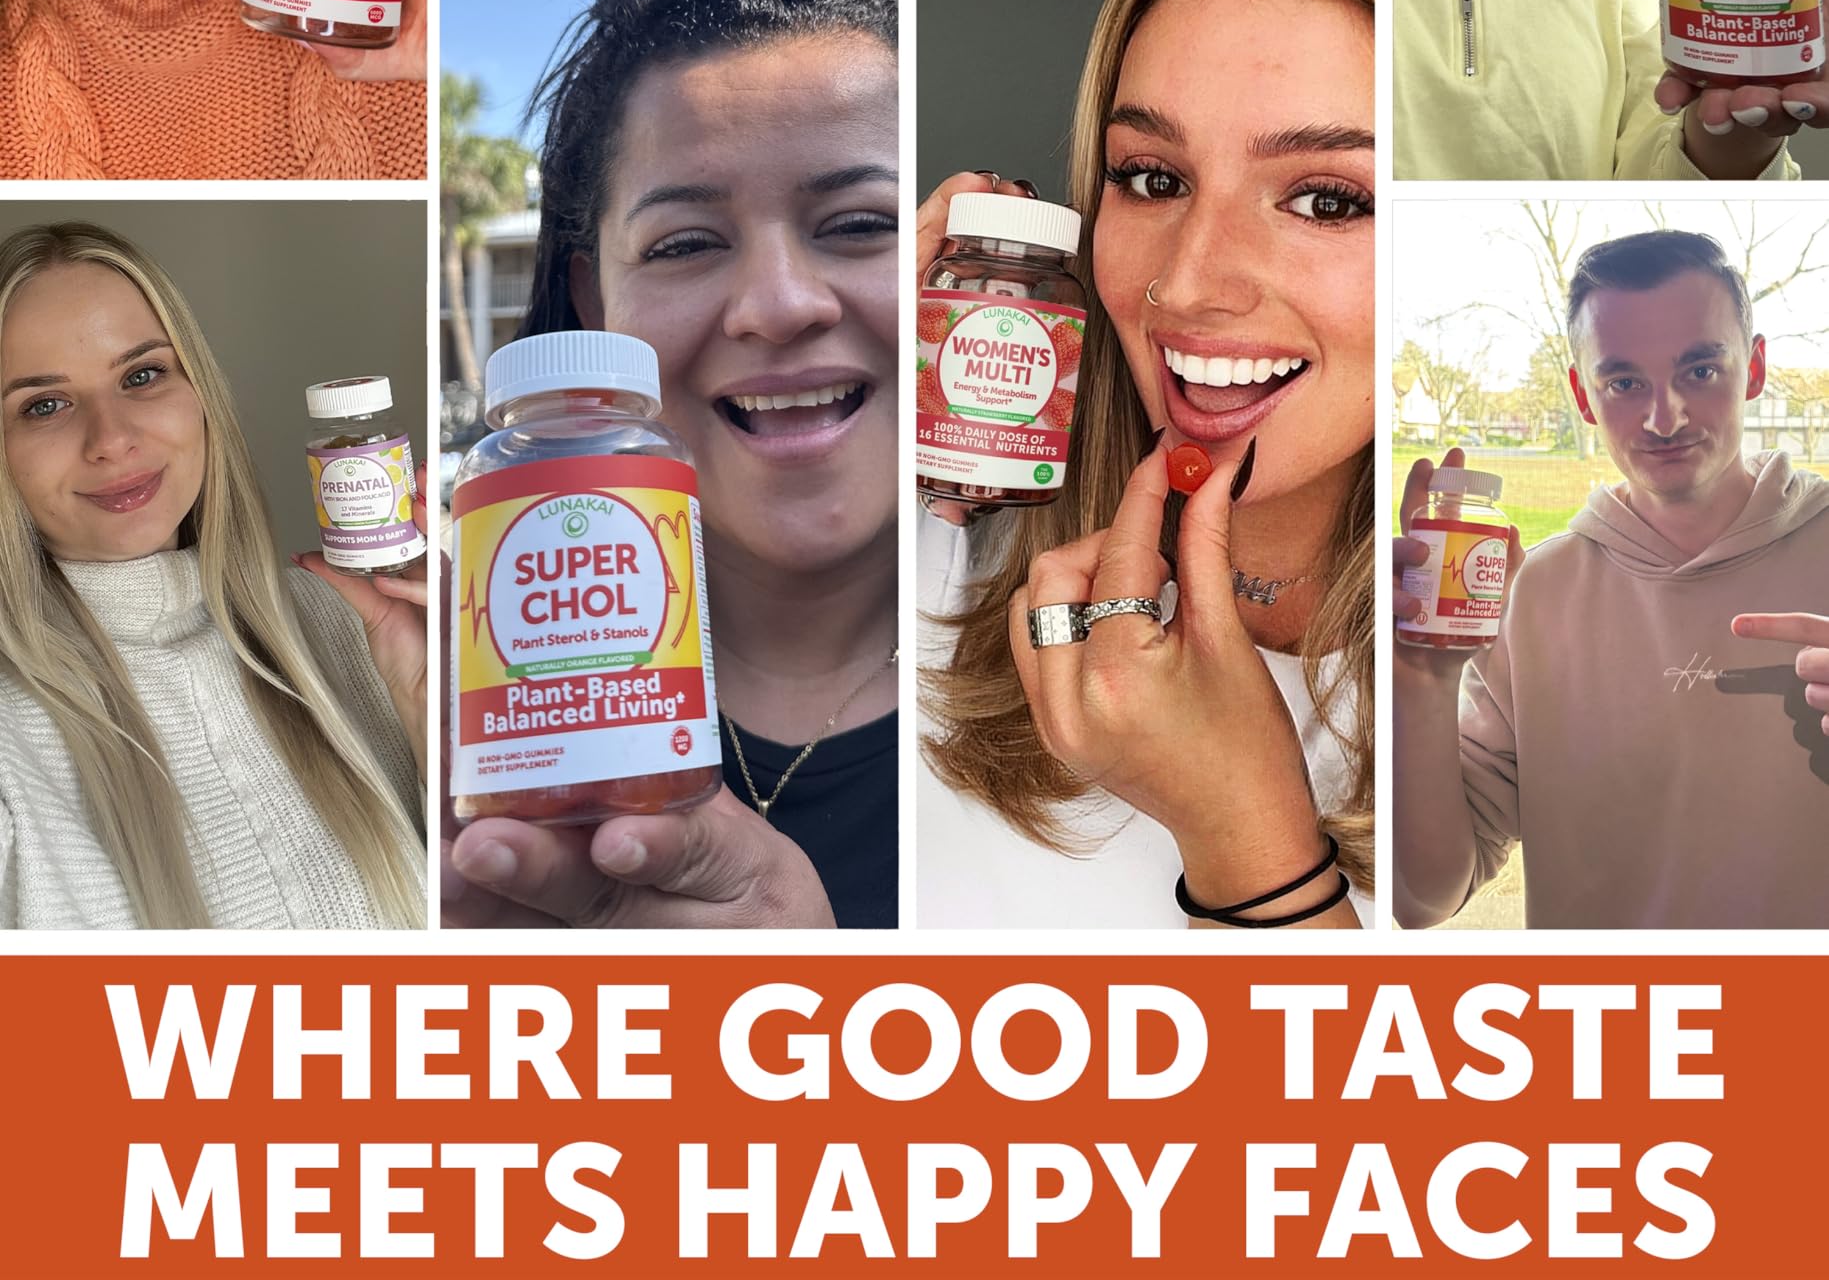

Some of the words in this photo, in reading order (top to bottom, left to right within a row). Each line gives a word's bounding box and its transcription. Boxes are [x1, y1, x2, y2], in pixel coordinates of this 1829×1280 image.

[274, 0, 307, 12] SUPPLEMENT
[287, 0, 311, 7] GUMMIES
[1702, 14, 1796, 30] Plant-Based
[1687, 24, 1757, 42] Balanced
[983, 308, 1030, 326] LUNAKAI
[953, 336, 1051, 367] WOMEN'S
[964, 359, 1032, 385] MULTI
[954, 382, 981, 394] Energy
[990, 387, 1037, 400] Metabolism
[919, 429, 931, 440] 16
[934, 431, 990, 450] ESSENTIAL
[996, 442, 1057, 456] NUTRIENTS
[934, 422, 962, 434] 100%
[965, 427, 996, 439] DAILY
[999, 431, 1028, 443] DOSE
[1030, 435, 1046, 445] OF
[333, 459, 366, 468] LUNAKAI
[923, 453, 951, 463] NON-GMO
[952, 459, 978, 468] GUMMIES
[937, 463, 973, 474] SUPPLEMENT
[322, 477, 389, 493] PRENATAL
[538, 498, 614, 520] LUNAKAI
[324, 534, 355, 543] SUPPORTS
[357, 536, 378, 544] MOM
[515, 544, 640, 585] SUPER
[521, 583, 637, 624] CHOL
[512, 637, 544, 650] Plant
[547, 630, 586, 646] Sterol
[591, 630, 600, 640] &
[603, 626, 648, 639] Stanols
[526, 661, 564, 672] NATURALLY
[566, 658, 597, 668] ORANGE
[598, 655, 634, 664] FLAVORED
[507, 672, 661, 708] Plant-Based
[483, 703, 595, 735] Balanced
[486, 750, 522, 763] NON-GMO
[524, 747, 564, 758] GUMMIES
[478, 764, 504, 774] DIETARY
[506, 759, 558, 772] SUPPLEMENT
